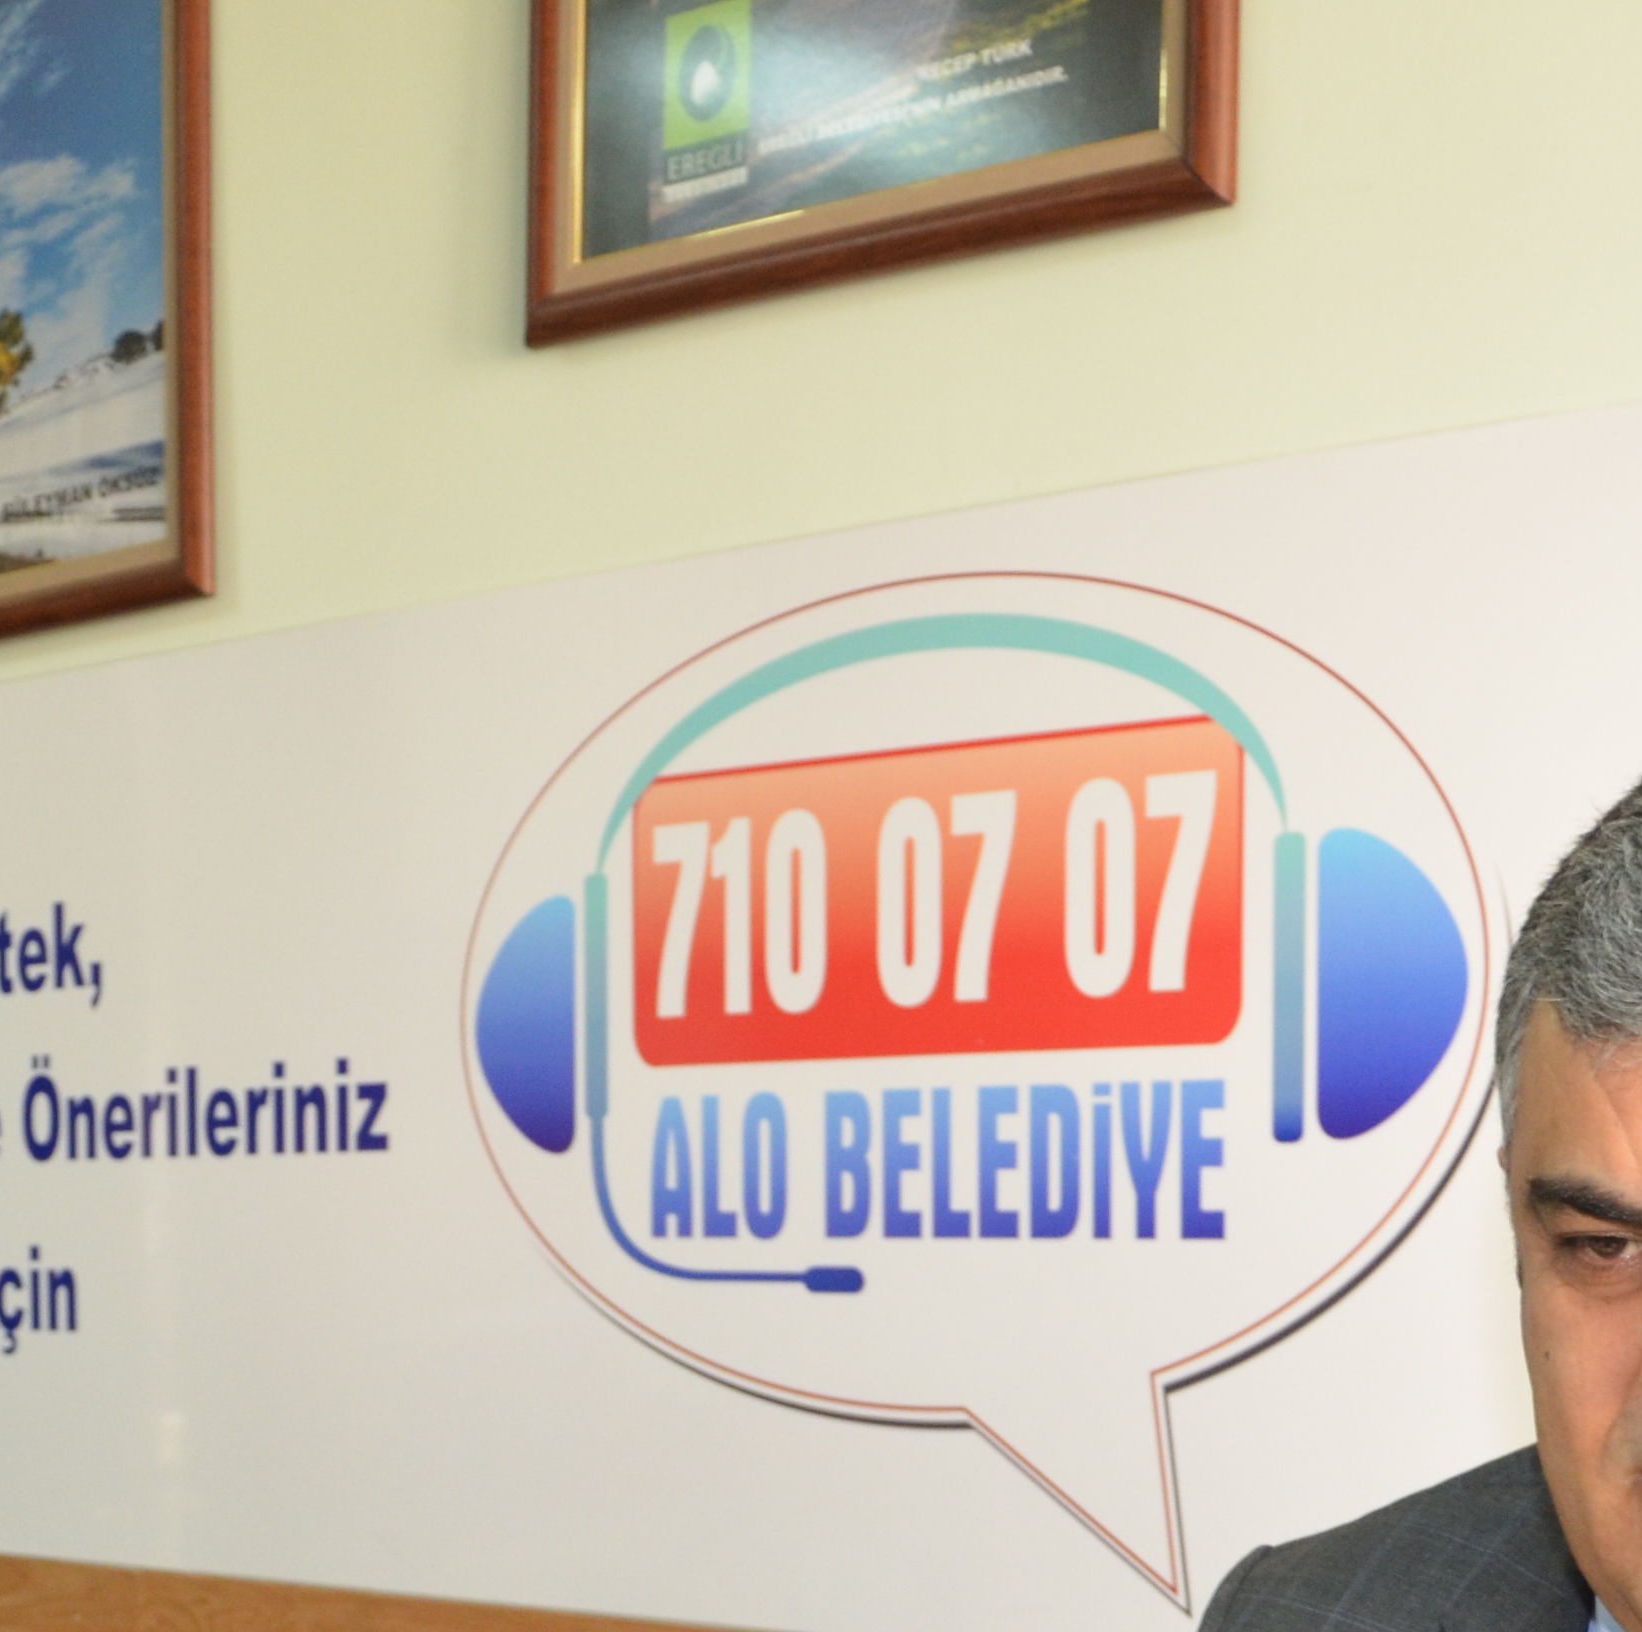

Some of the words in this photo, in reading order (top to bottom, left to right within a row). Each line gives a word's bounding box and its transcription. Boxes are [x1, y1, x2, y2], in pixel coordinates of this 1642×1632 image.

[653, 808, 828, 1020] 710
[877, 790, 1018, 1008] 07
[1064, 770, 1218, 999] 07
[23, 1055, 390, 1162] Önerileriniz
[651, 1091, 788, 1240] ALO
